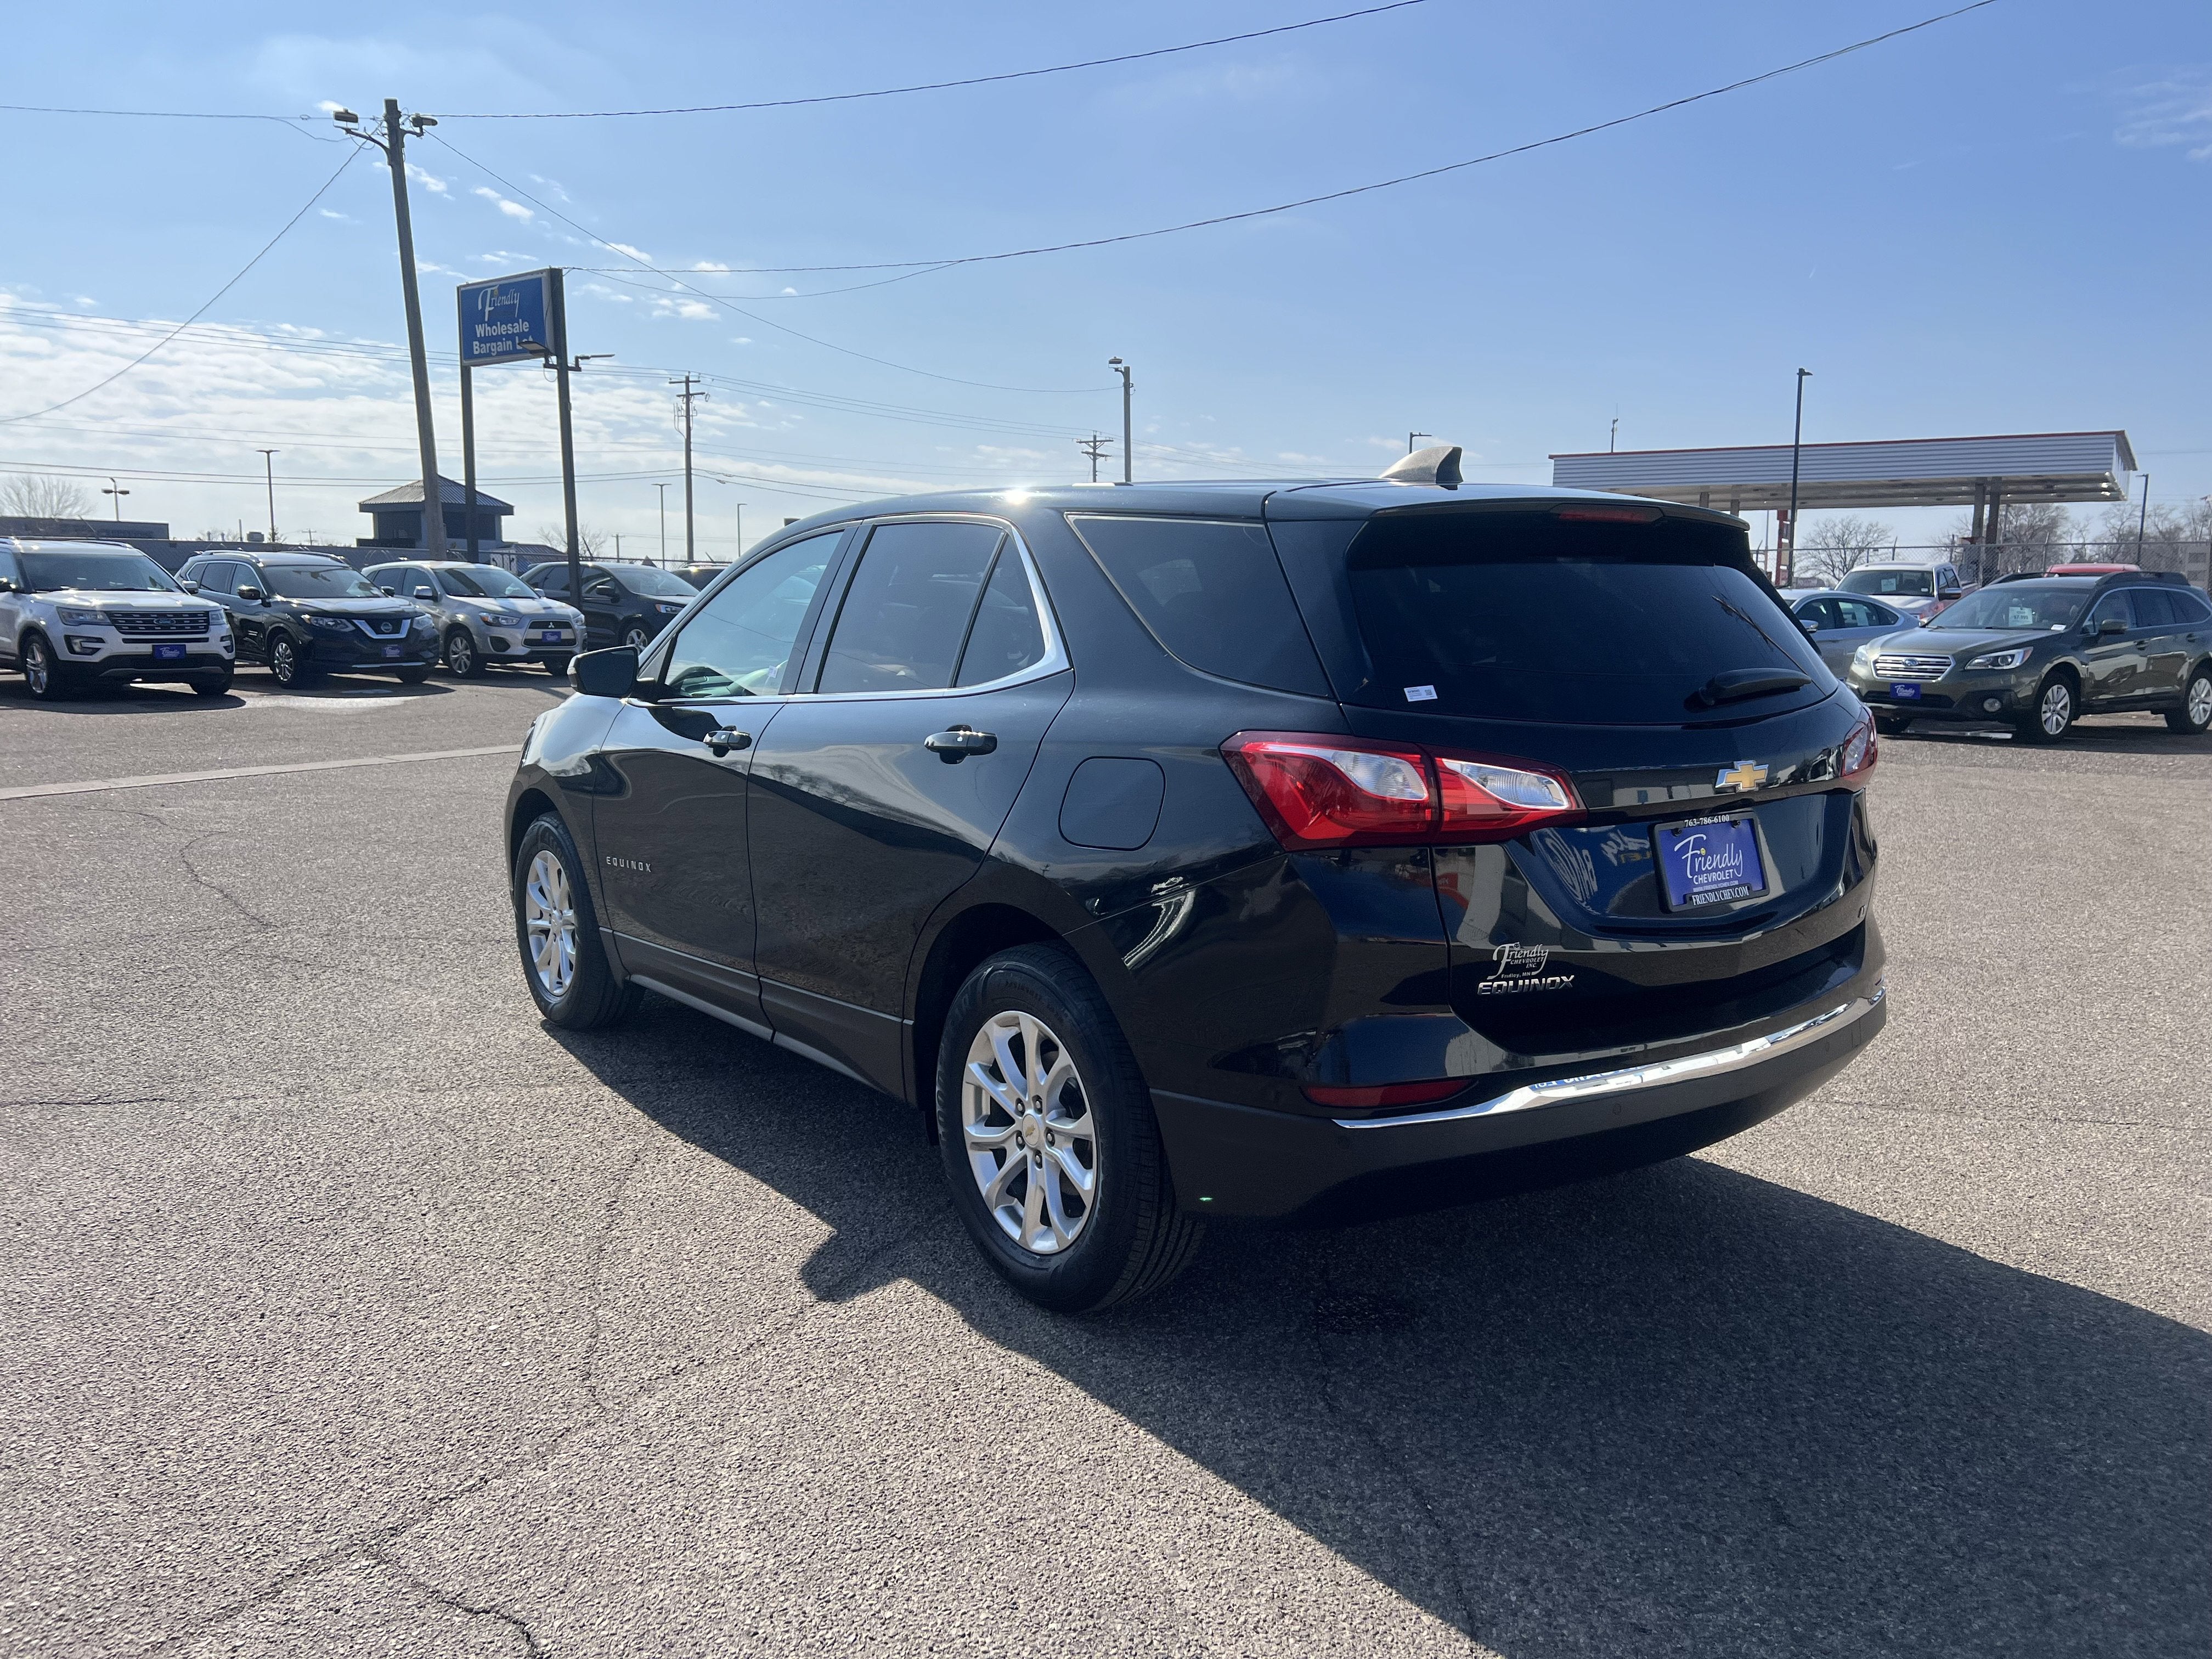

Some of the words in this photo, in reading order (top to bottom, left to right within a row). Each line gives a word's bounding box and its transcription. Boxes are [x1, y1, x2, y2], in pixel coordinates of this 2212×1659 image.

[478, 284, 520, 321] Friendly
[475, 319, 529, 337] Wholesale
[473, 338, 512, 356] Bargain
[1684, 814, 1730, 827] 763-786-6100
[606, 856, 652, 873] EQUINOX
[1674, 833, 1743, 879] Friendly
[1693, 869, 1734, 885] CHEVROLET
[1692, 886, 1750, 906] FRIENDLYCHEV.COM
[1487, 941, 1549, 980] Friendly
[1477, 975, 1575, 996] EQUINOX
